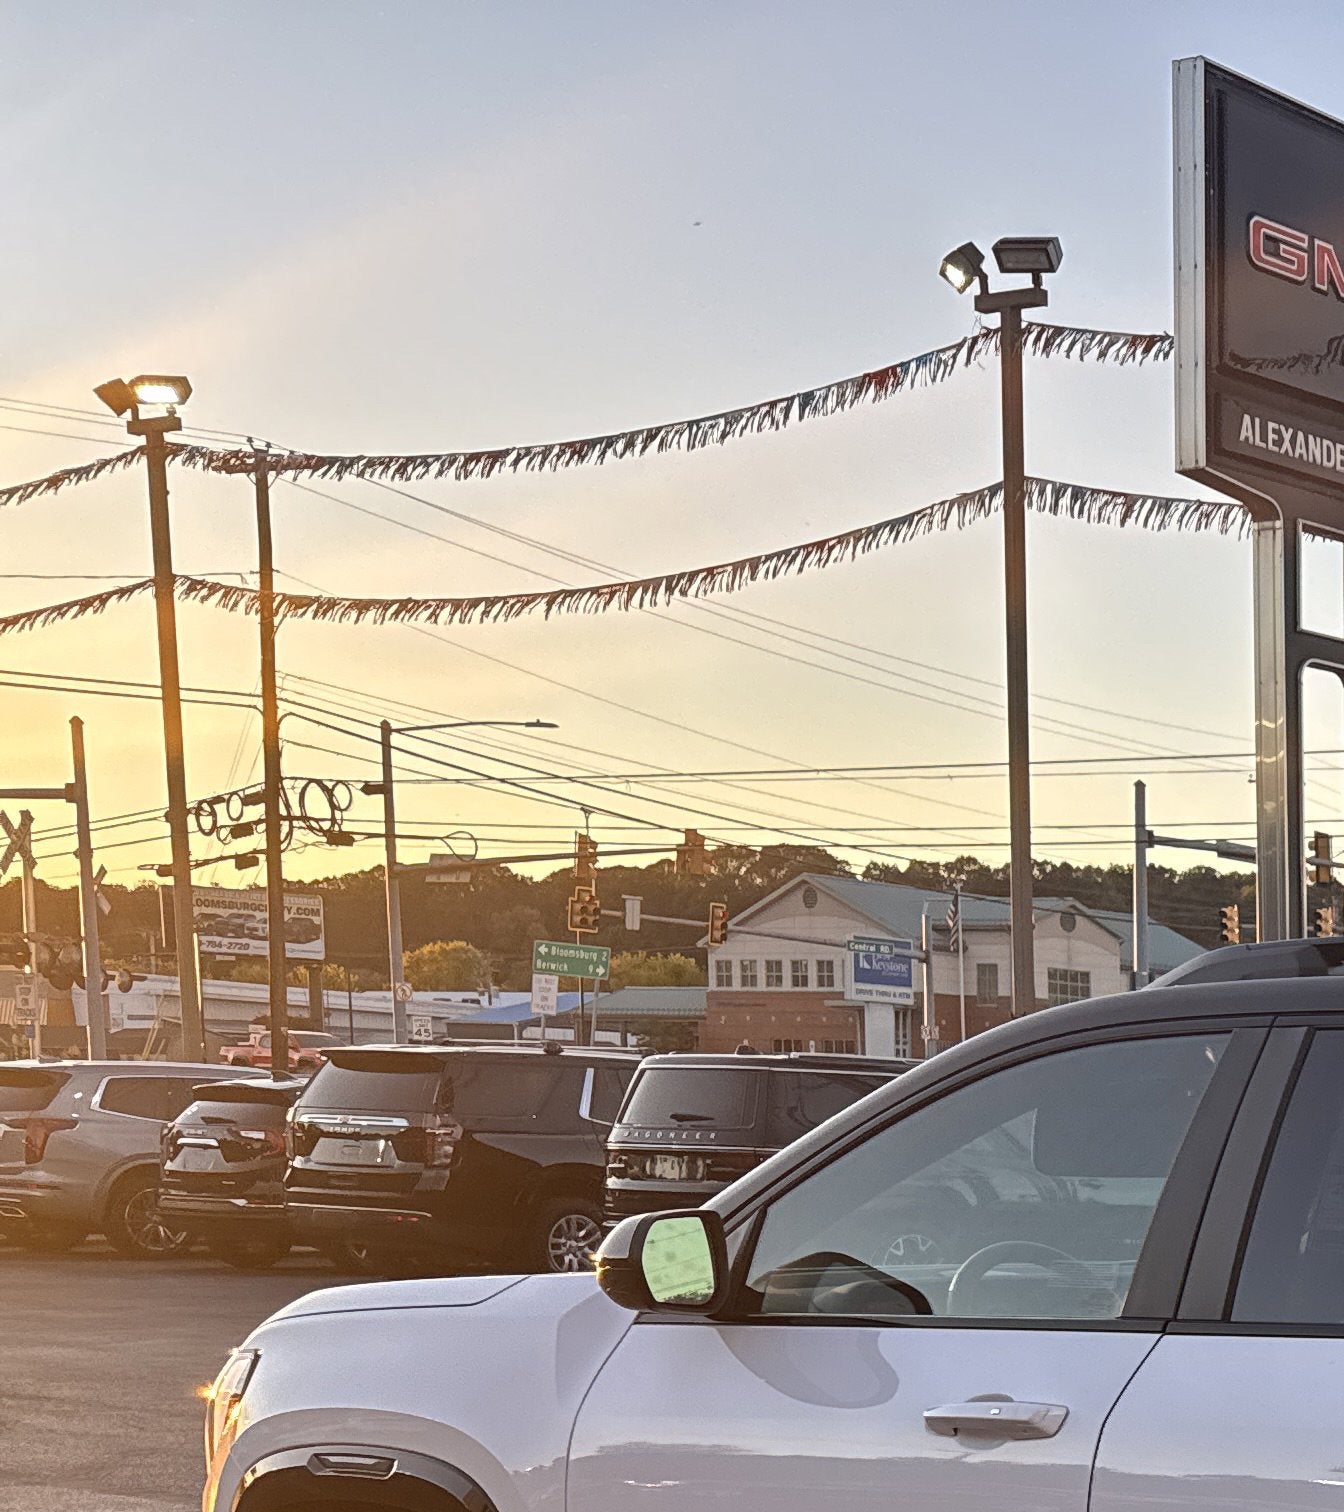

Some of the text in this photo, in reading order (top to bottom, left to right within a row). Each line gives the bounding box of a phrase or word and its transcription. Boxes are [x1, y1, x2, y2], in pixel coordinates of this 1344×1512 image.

[550, 945, 609, 962] Bloomsburg 2
[849, 942, 876, 952] Central
[535, 958, 594, 974] Berwick 9
[871, 957, 909, 973] Keystone
[414, 1028, 432, 1038] 45
